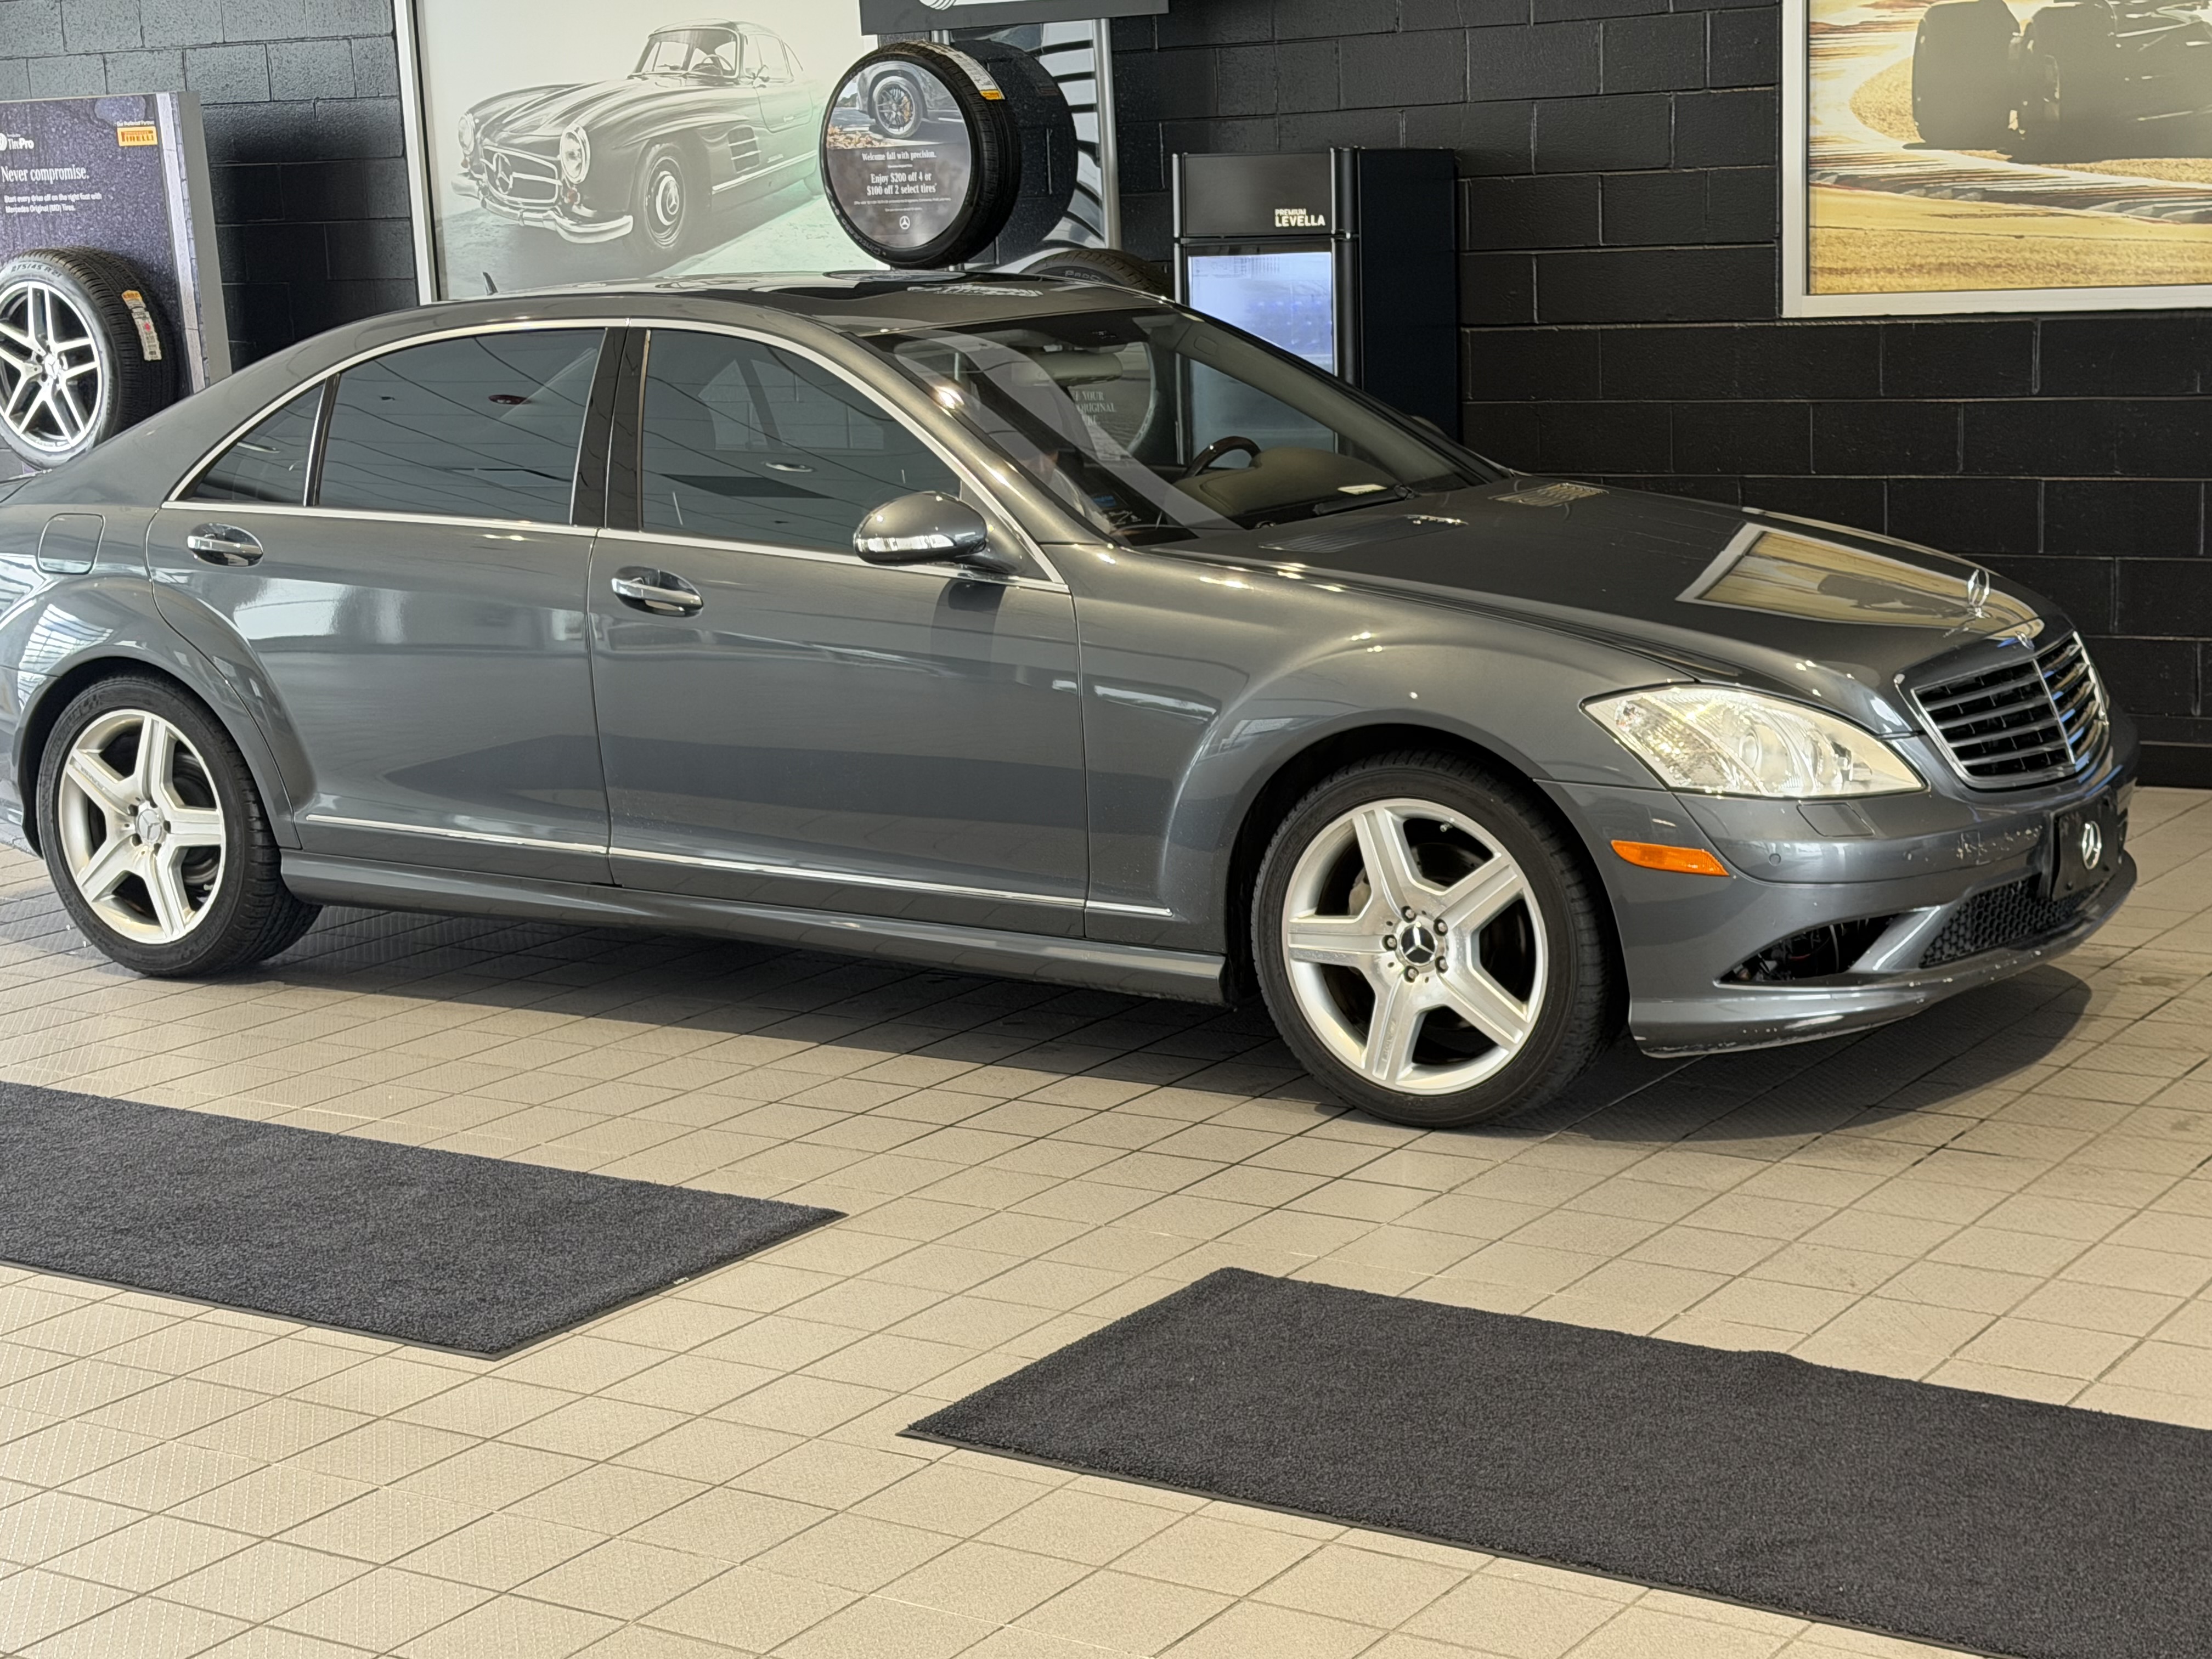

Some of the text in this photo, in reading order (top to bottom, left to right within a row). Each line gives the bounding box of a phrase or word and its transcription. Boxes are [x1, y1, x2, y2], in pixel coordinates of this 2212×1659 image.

[121, 130, 154, 142] PIRELLI
[862, 149, 937, 161] Welcome fall with precision.
[1, 164, 90, 185] Never compromise.
[871, 173, 889, 185] Enjoy
[890, 172, 906, 183] $200
[907, 172, 917, 182] off
[924, 172, 932, 181] or
[866, 185, 883, 196] $100
[884, 185, 893, 195] off
[895, 185, 900, 195] 2
[900, 184, 919, 194] select
[1275, 215, 1325, 228] LEVELLA
